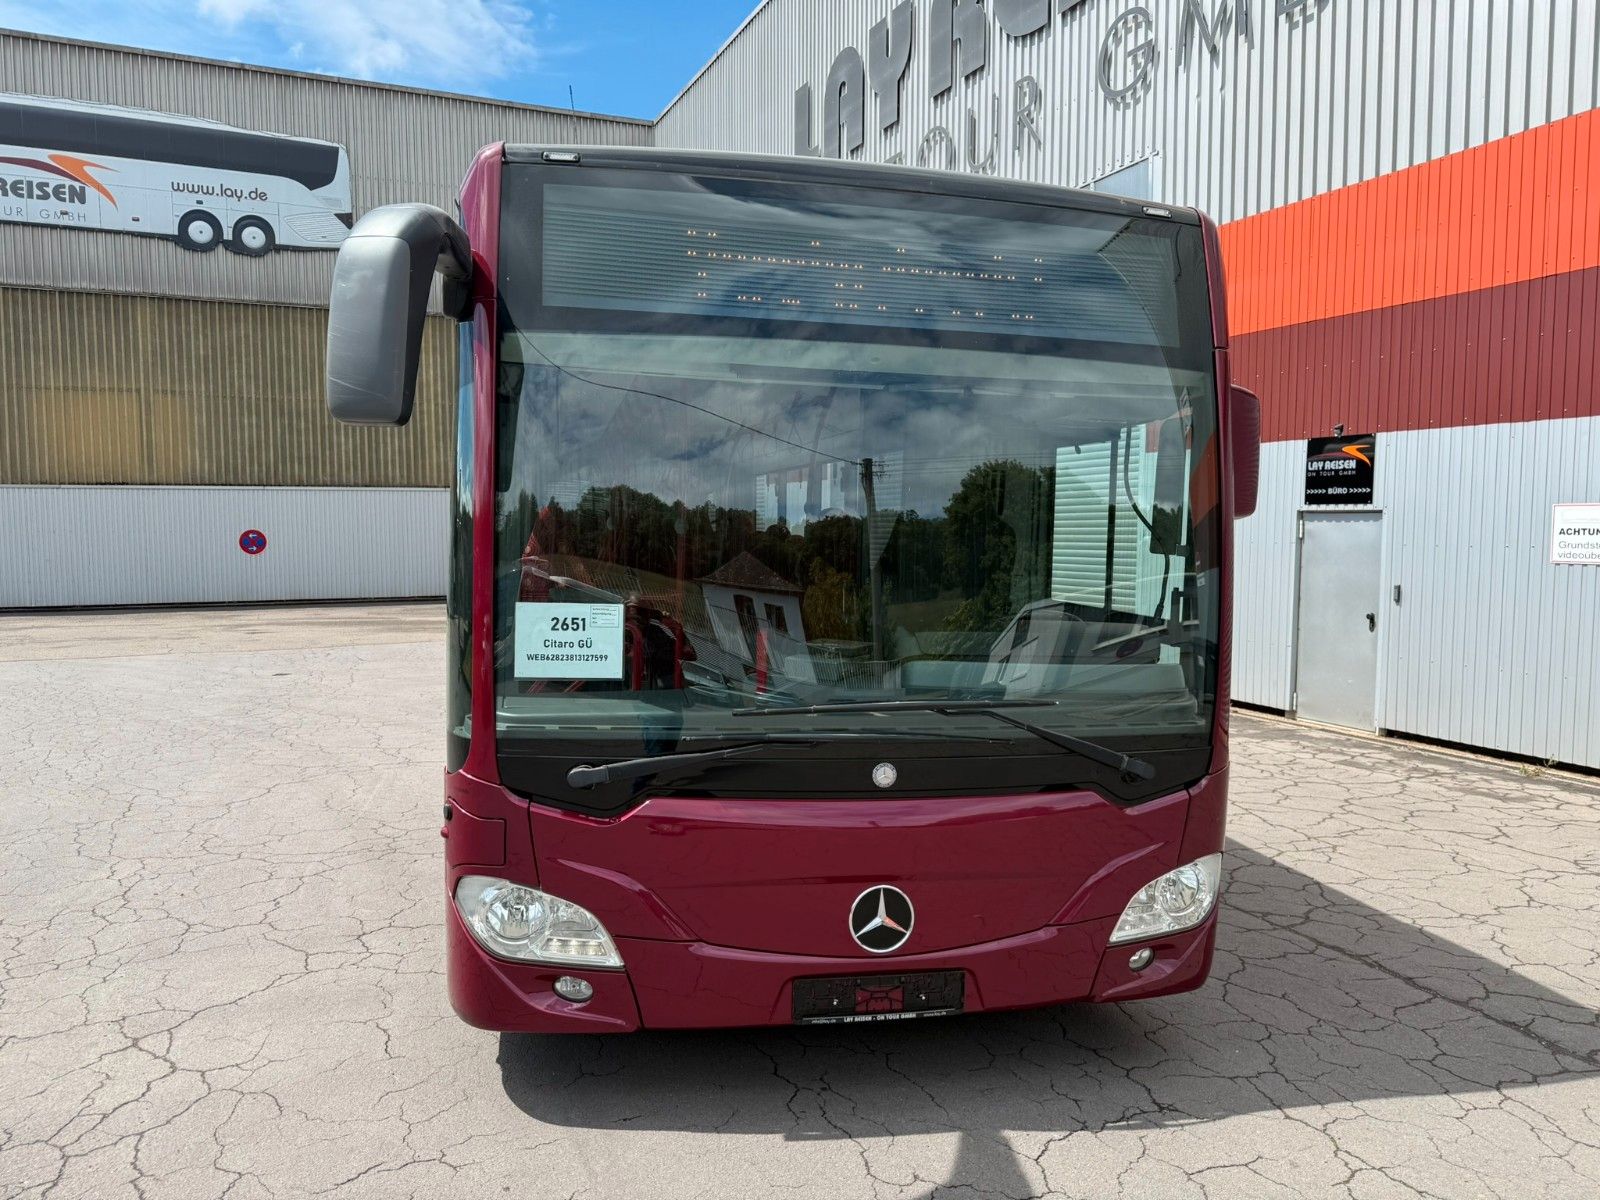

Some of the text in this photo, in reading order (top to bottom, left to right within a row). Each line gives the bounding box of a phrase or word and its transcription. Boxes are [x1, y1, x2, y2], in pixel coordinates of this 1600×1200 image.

[794, 0, 912, 158] LAY
[884, 75, 1041, 172] OUR
[0, 176, 87, 205] REISEN
[171, 181, 268, 202] www.lay.de
[39, 208, 87, 222] GMBH
[1308, 460, 1356, 470] LAY REISEN
[1327, 486, 1348, 495] BÜRO
[1558, 541, 1600, 549] Grundst
[550, 616, 586, 632] 2651
[543, 637, 593, 649] Citaro GÜ
[526, 653, 609, 662] WEB62823813127599
[843, 1015, 854, 1023] LAY
